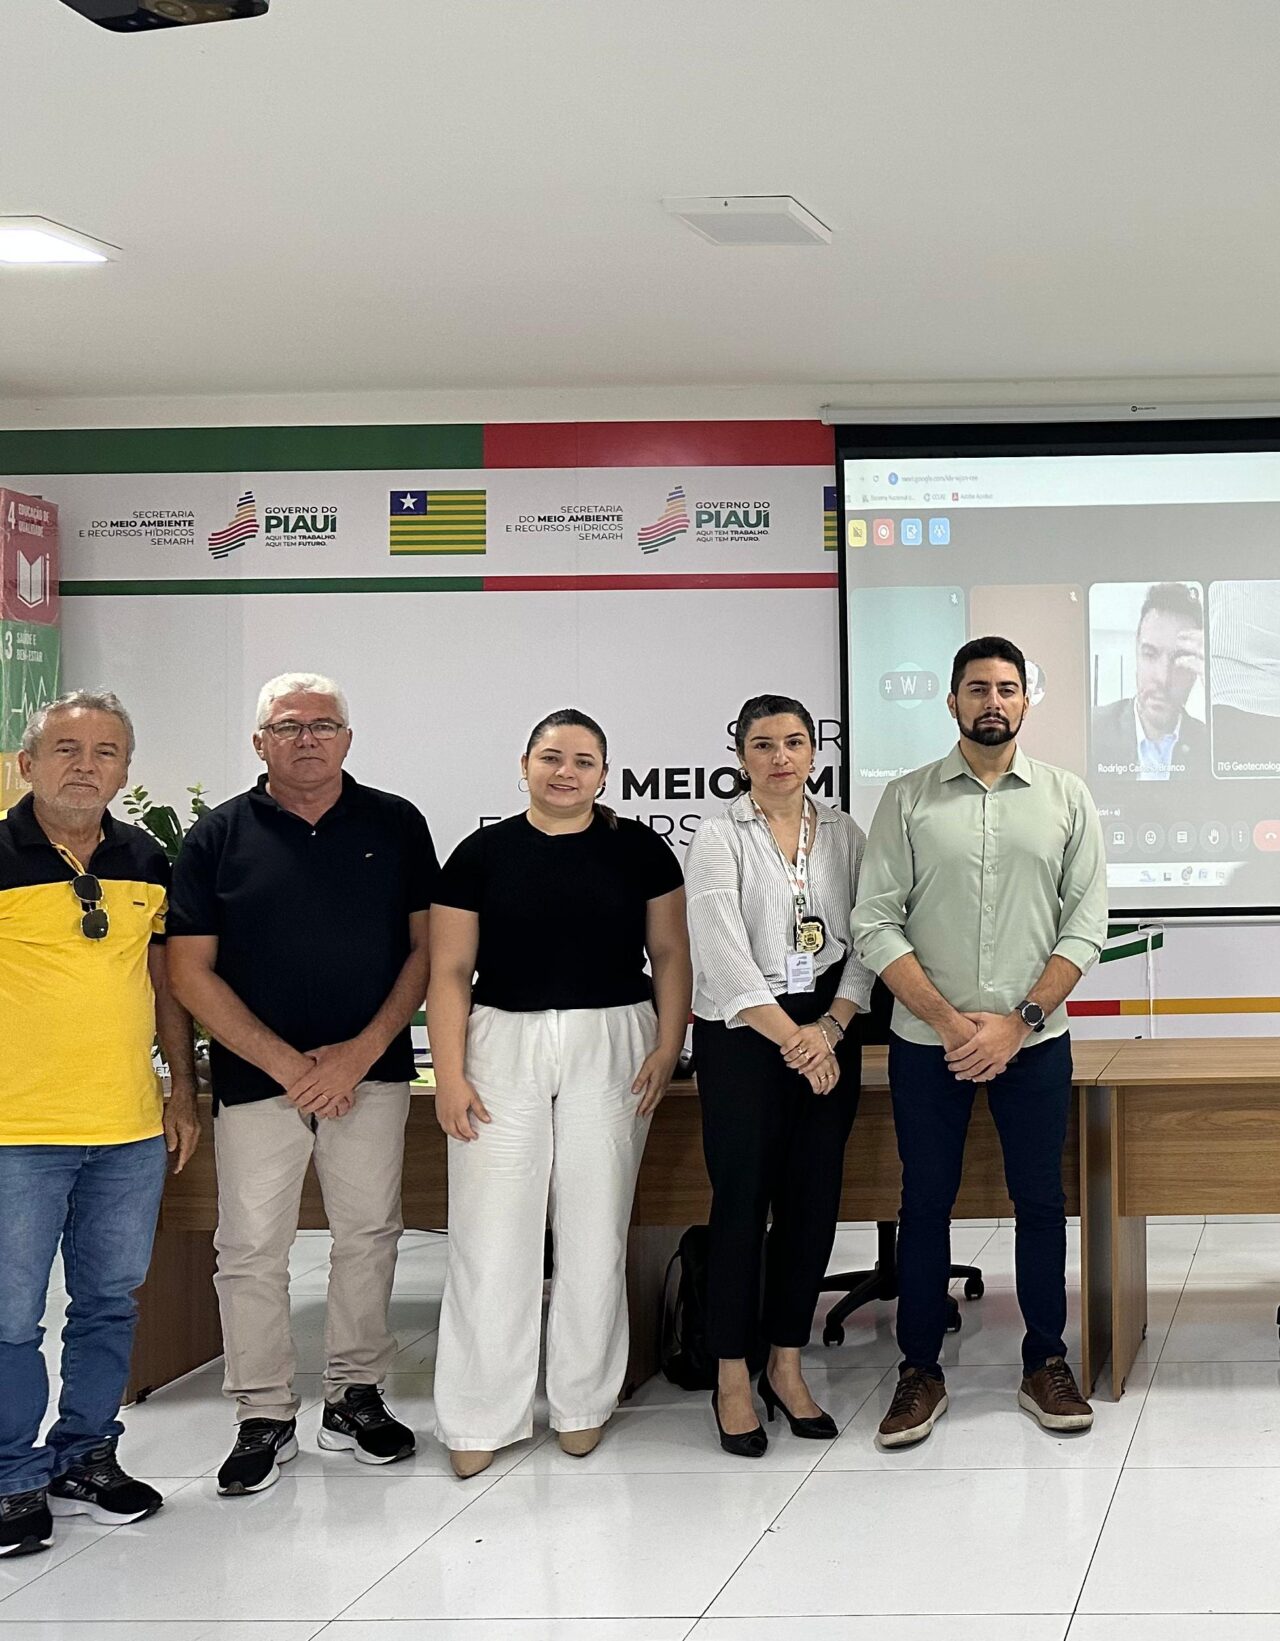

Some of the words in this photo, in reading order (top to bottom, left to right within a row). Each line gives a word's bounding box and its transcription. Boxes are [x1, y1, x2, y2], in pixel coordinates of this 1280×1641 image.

[265, 506, 318, 514] GOVERNO
[321, 506, 338, 514] DO
[560, 505, 623, 514] SECRETARIA
[695, 501, 750, 509] GOVERNO
[753, 501, 771, 509] DO
[7, 501, 16, 530] 4
[132, 510, 194, 519] SECRETARIA
[519, 515, 535, 523] DO
[537, 514, 565, 523] MEIO
[568, 513, 623, 523] AMBIENTE
[695, 509, 770, 529] PIAUÍ
[91, 520, 108, 529] DO
[110, 520, 137, 528] MEIO
[140, 519, 194, 528] AMBIENTE
[265, 514, 337, 533] PIAUÍ
[506, 524, 512, 533] E
[515, 524, 571, 532] RECURSOS
[573, 522, 623, 532] HÍDRICOS
[79, 530, 85, 538] E
[88, 529, 143, 538] RECURSOS
[145, 527, 194, 537] HÍDRICOS
[578, 532, 623, 541] SEMARH
[150, 537, 194, 546] SEMARH
[5, 631, 13, 660] 3
[859, 768, 897, 778] Waldemar
[1098, 763, 1128, 775] Rodrigo
[622, 766, 741, 801] MEIO
